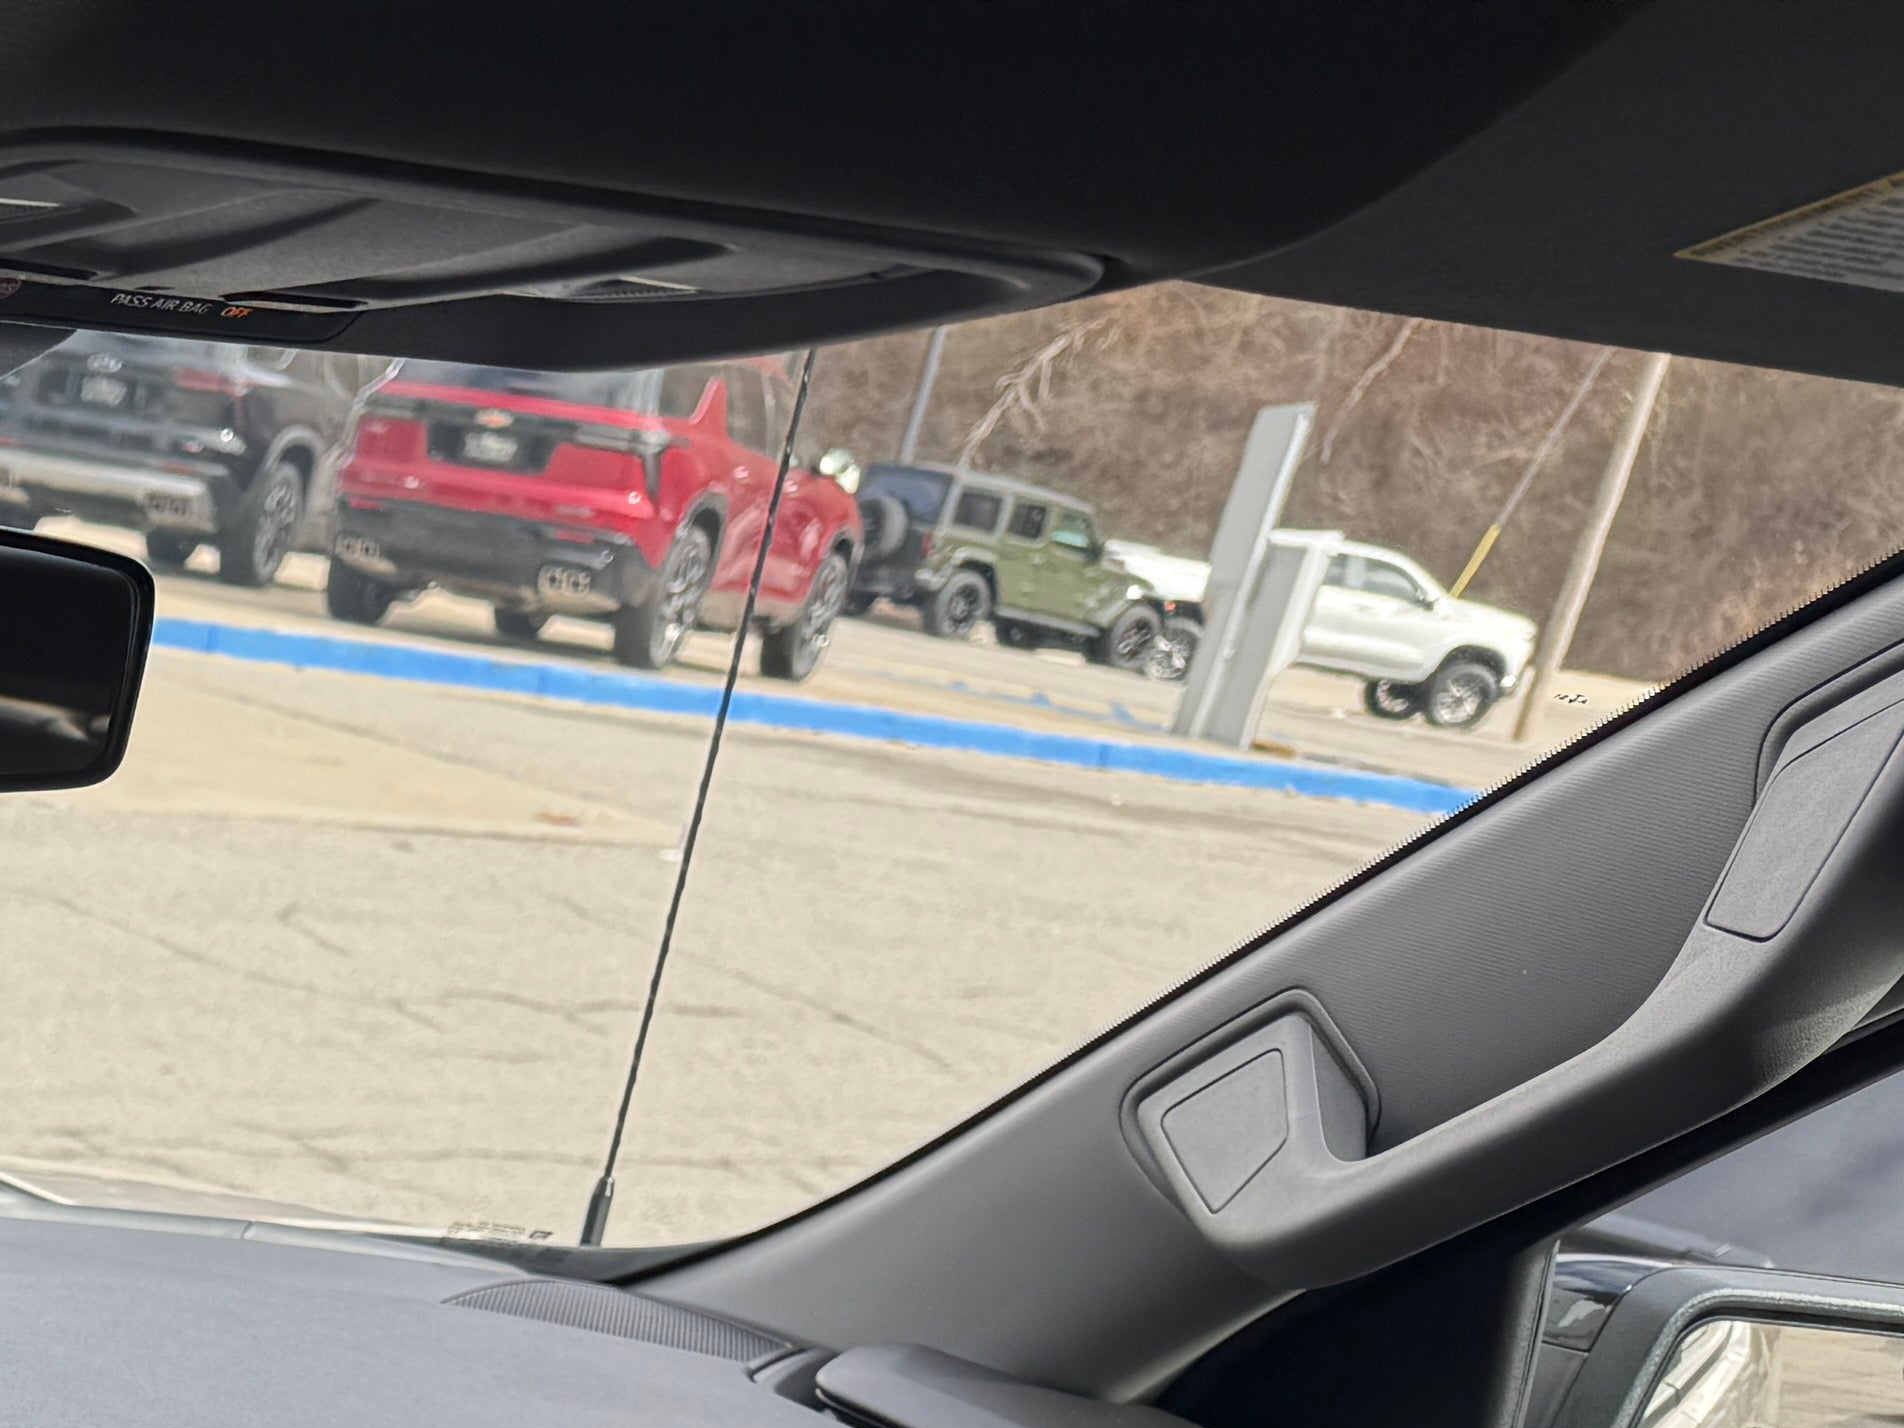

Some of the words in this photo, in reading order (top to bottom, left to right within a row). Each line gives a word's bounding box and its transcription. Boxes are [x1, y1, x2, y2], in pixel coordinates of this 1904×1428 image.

[111, 293, 149, 308] PASS
[151, 297, 180, 311] AIR
[179, 302, 214, 315] BAG
[220, 306, 254, 318] OFF
